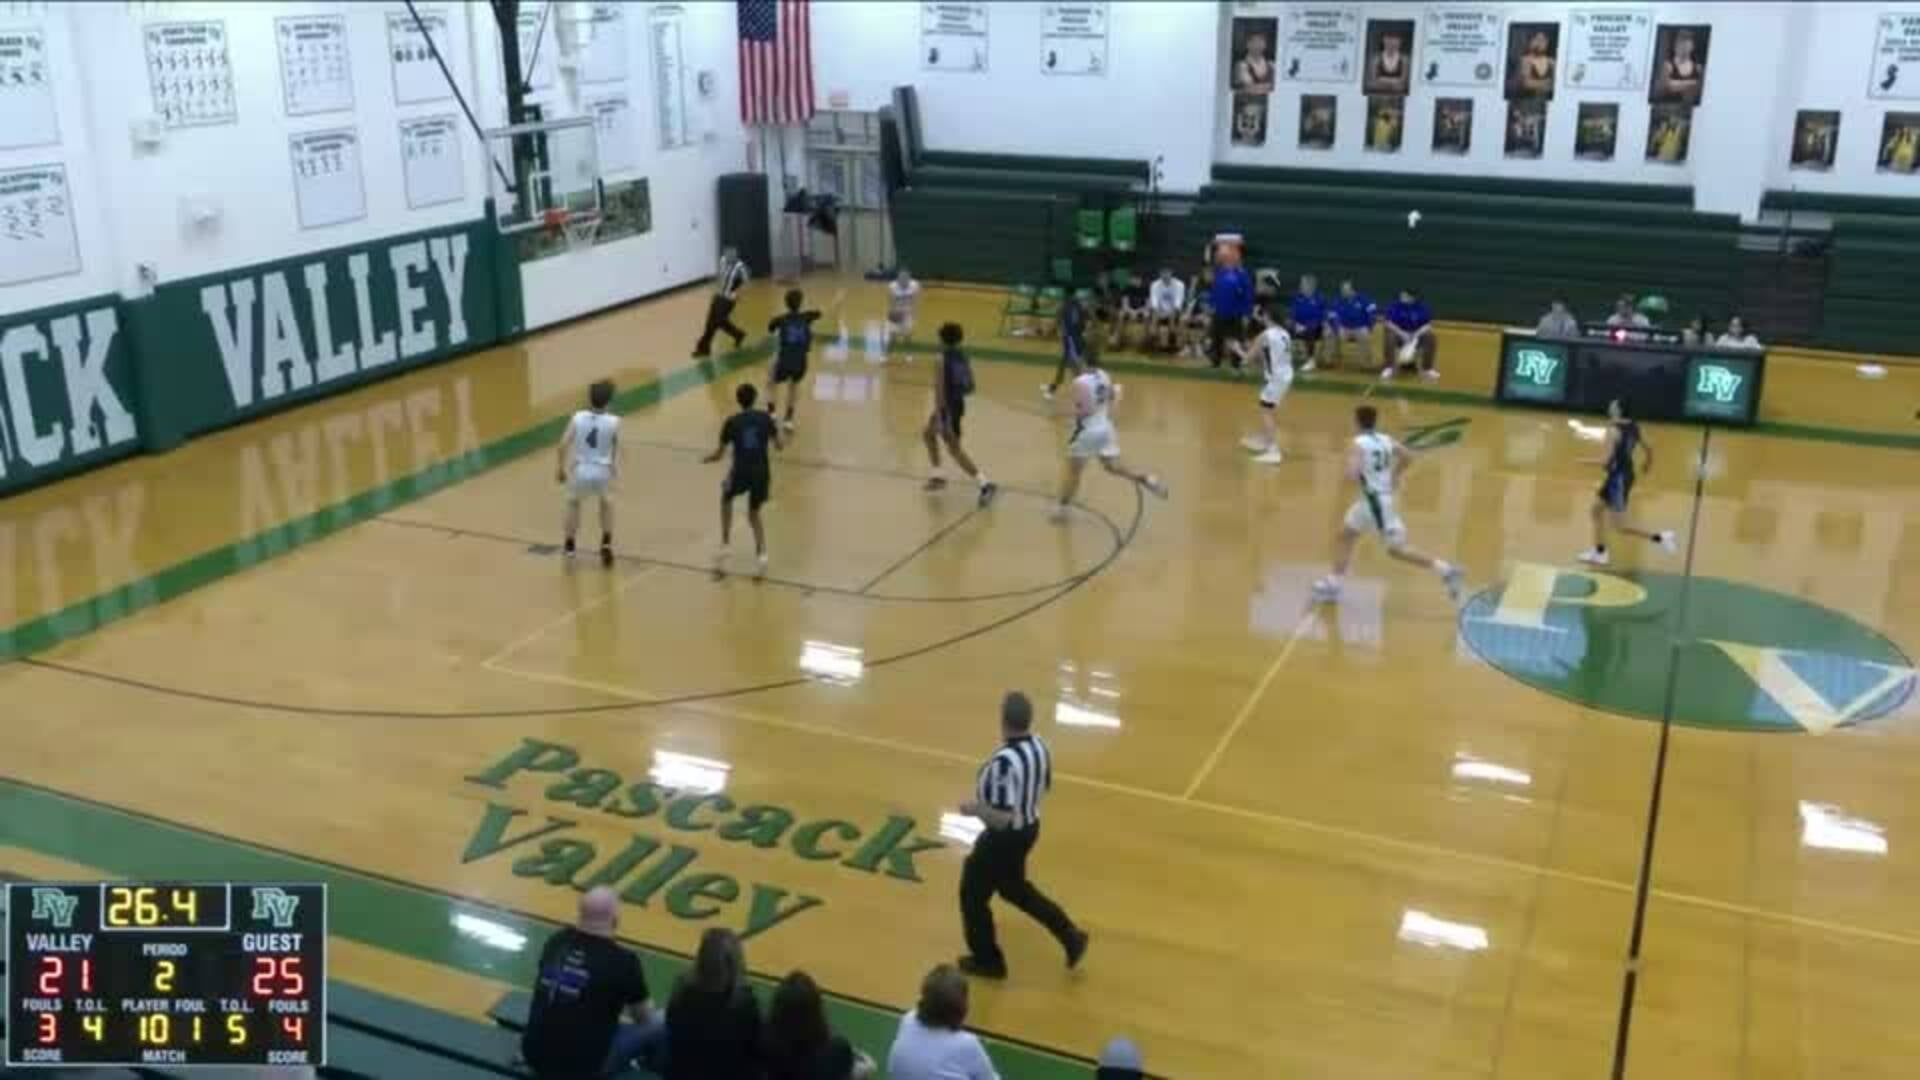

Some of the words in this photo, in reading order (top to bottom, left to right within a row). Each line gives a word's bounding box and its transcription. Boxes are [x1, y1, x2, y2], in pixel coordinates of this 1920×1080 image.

[201, 234, 469, 409] VALLEY
[1516, 350, 1558, 385] PV
[1697, 365, 1742, 401] PV
[0, 307, 138, 477] CK
[586, 427, 599, 449] 4
[460, 801, 824, 939] Valley
[464, 737, 945, 883] Pascack
